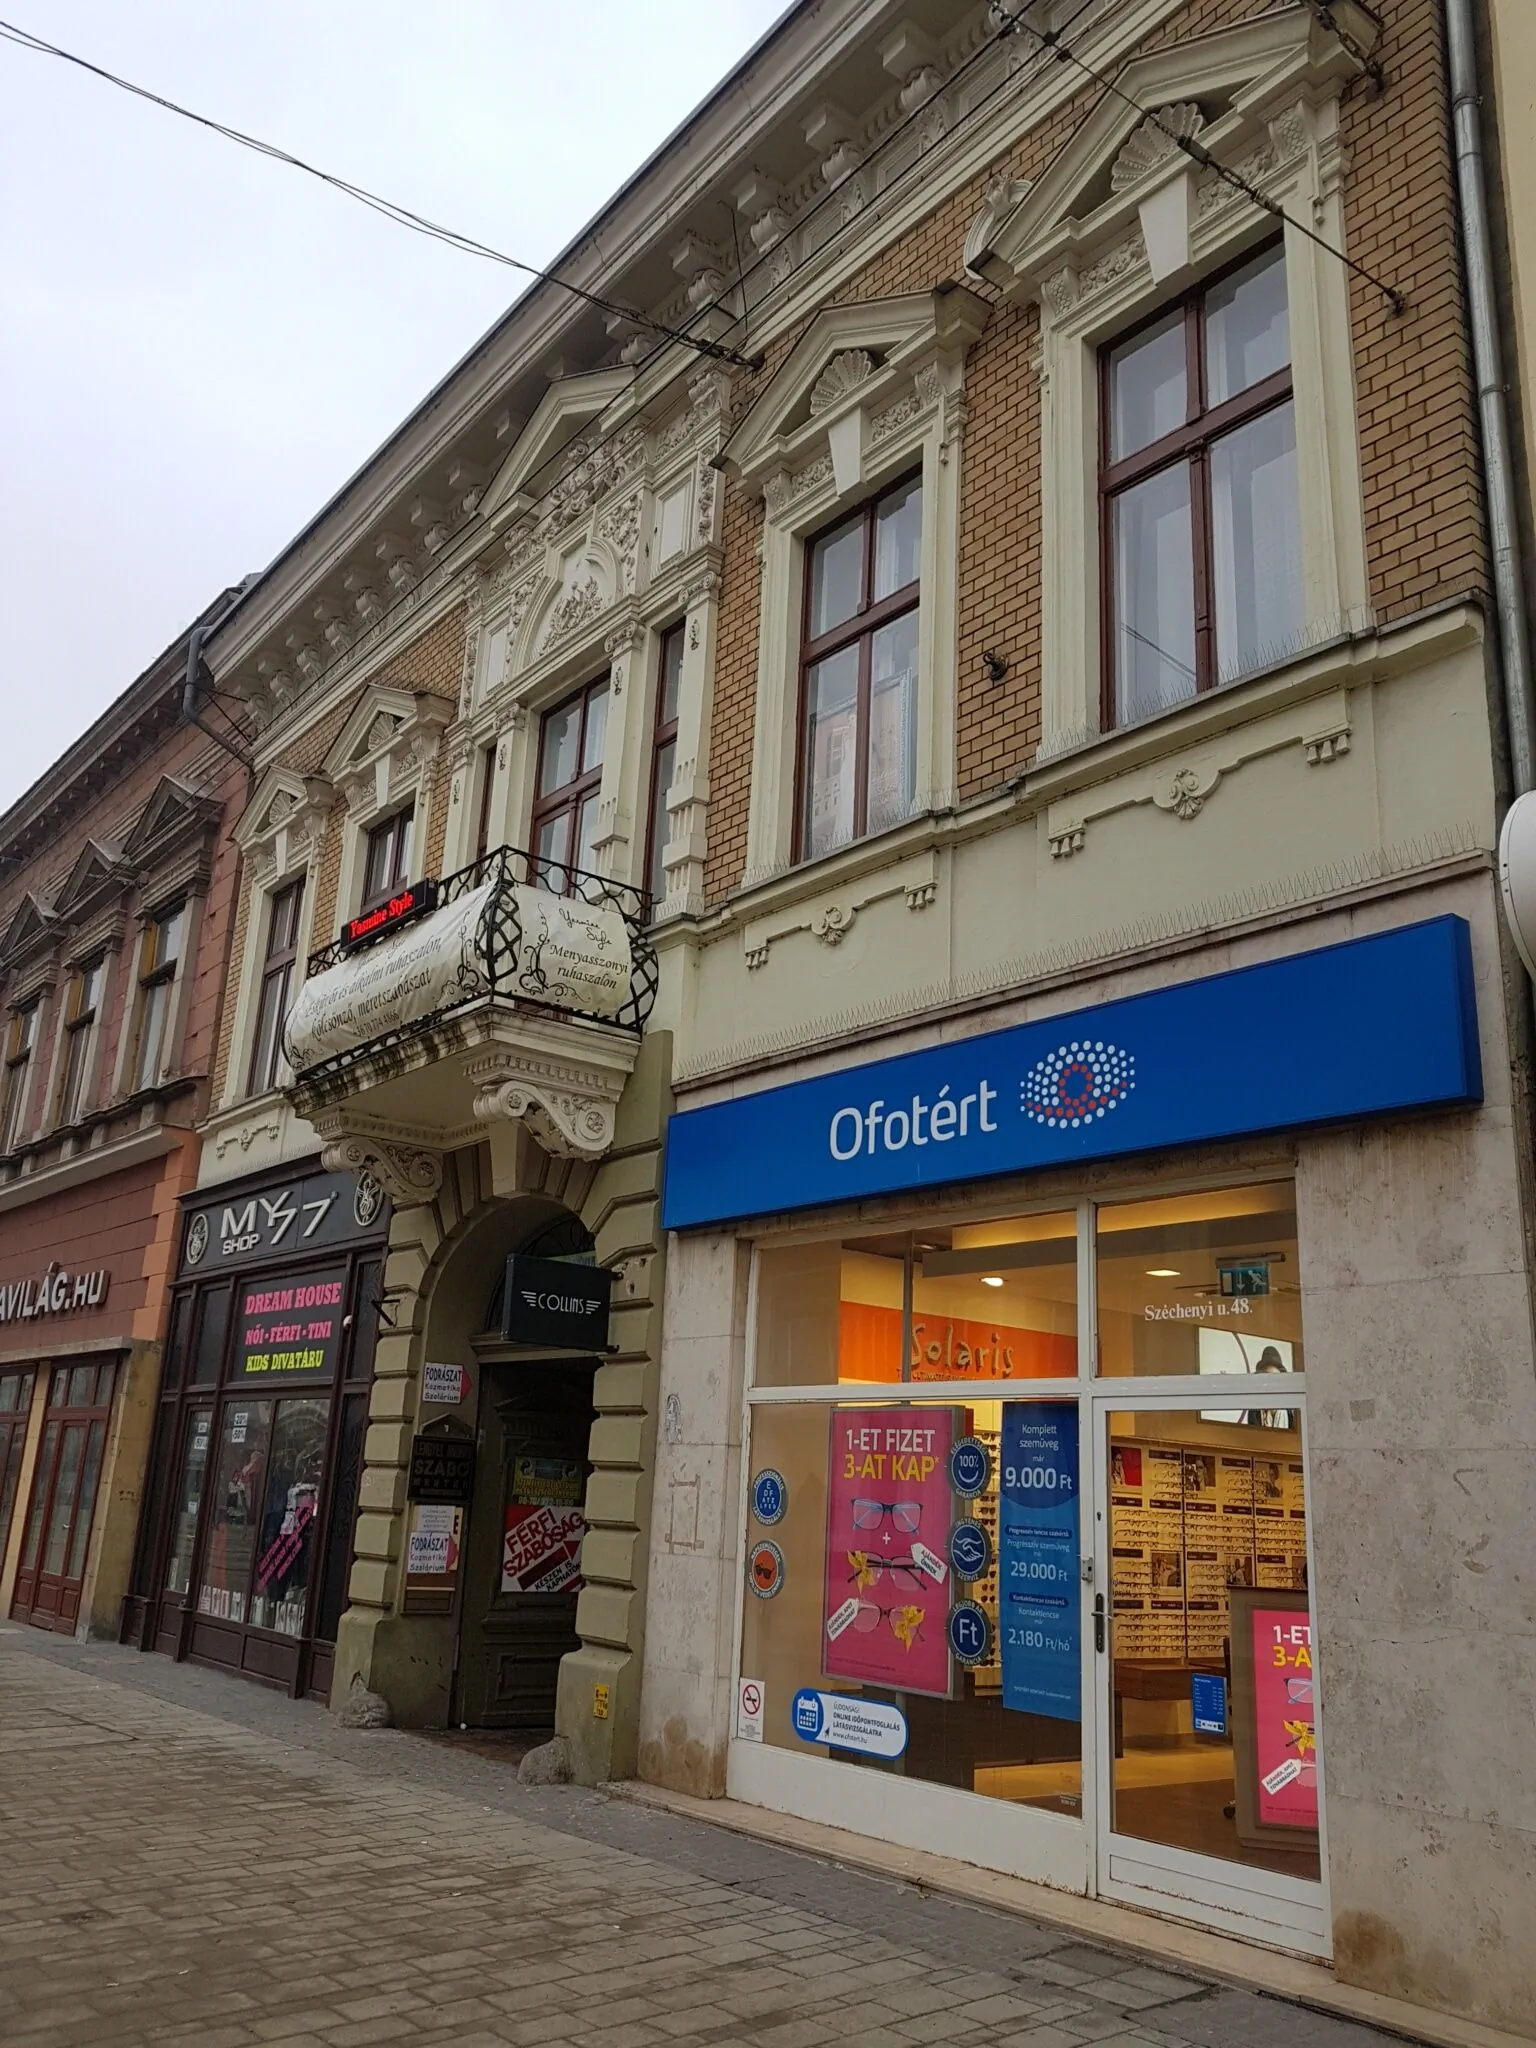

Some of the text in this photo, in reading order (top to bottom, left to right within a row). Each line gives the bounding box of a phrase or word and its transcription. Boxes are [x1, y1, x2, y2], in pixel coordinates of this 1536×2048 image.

[350, 891, 414, 938] Yasmine Style
[549, 944, 628, 976] Menyasszonyi
[557, 965, 617, 990] ruhaszalon
[829, 1079, 998, 1160] Ofotért
[222, 1233, 261, 1256] SHOP
[245, 1282, 342, 1315] DREAM HOUSE
[537, 1292, 585, 1314] COLLINS
[1144, 1300, 1214, 1322] Széchenyi
[269, 1321, 301, 1344] FÉRFI
[308, 1320, 332, 1339] TINI
[246, 1347, 324, 1372] KIDS DIVATÁRU
[911, 1322, 1014, 1378] Solaris
[425, 1365, 462, 1382] FODRÁSZAT
[846, 1428, 935, 1453] 1-ET FIZET
[1022, 1423, 1057, 1437] Komplett
[1019, 1439, 1059, 1451] szemüveg
[843, 1453, 887, 1480] 3-AT
[959, 1455, 979, 1468] 100%
[1032, 1454, 1044, 1462] már
[1005, 1466, 1072, 1490] 9.000 Ft
[505, 1507, 557, 1555] FÉRFI
[411, 1533, 449, 1552] FODRÁSZAT
[564, 1559, 573, 1569] IS
[1010, 1560, 1068, 1582] 29.000 Ft
[1018, 1607, 1060, 1619] Kontaktlencse
[959, 1618, 979, 1646] Ft
[1008, 1628, 1043, 1648] 2.180
[833, 1711, 900, 1732] ONLINE IDŐPONTFOGLALÁS
[833, 1720, 883, 1737] LÁTÁSVIZSGÁLATRA
